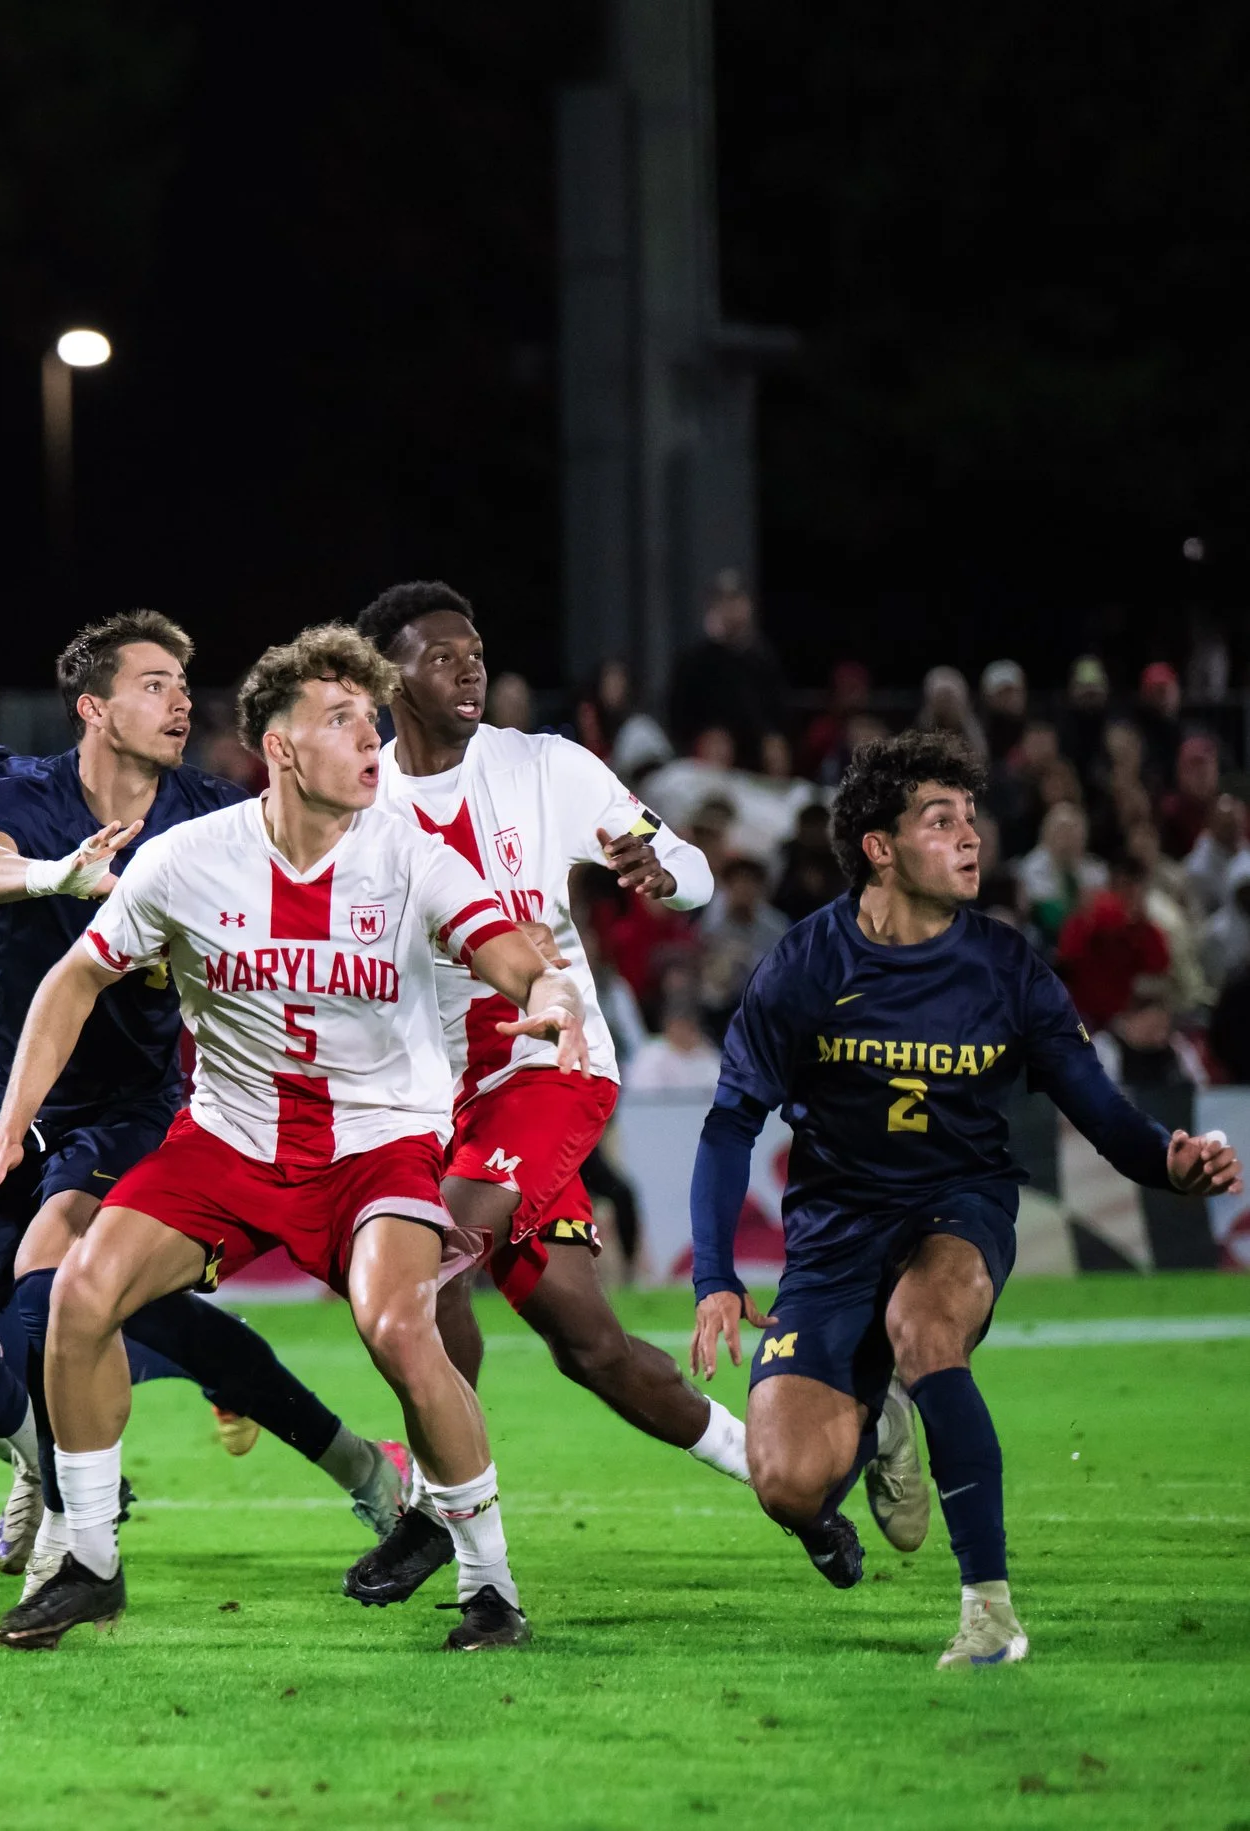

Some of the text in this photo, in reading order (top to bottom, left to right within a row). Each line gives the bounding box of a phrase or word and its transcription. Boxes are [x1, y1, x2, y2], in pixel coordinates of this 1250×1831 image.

[360, 916, 376, 933] M
[205, 947, 399, 1003] MARYLAND
[284, 1003, 317, 1063] 5
[817, 1035, 1006, 1076] MICHIGAN
[887, 1077, 928, 1133] 2
[484, 1148, 522, 1173] M
[761, 1331, 798, 1365] M
